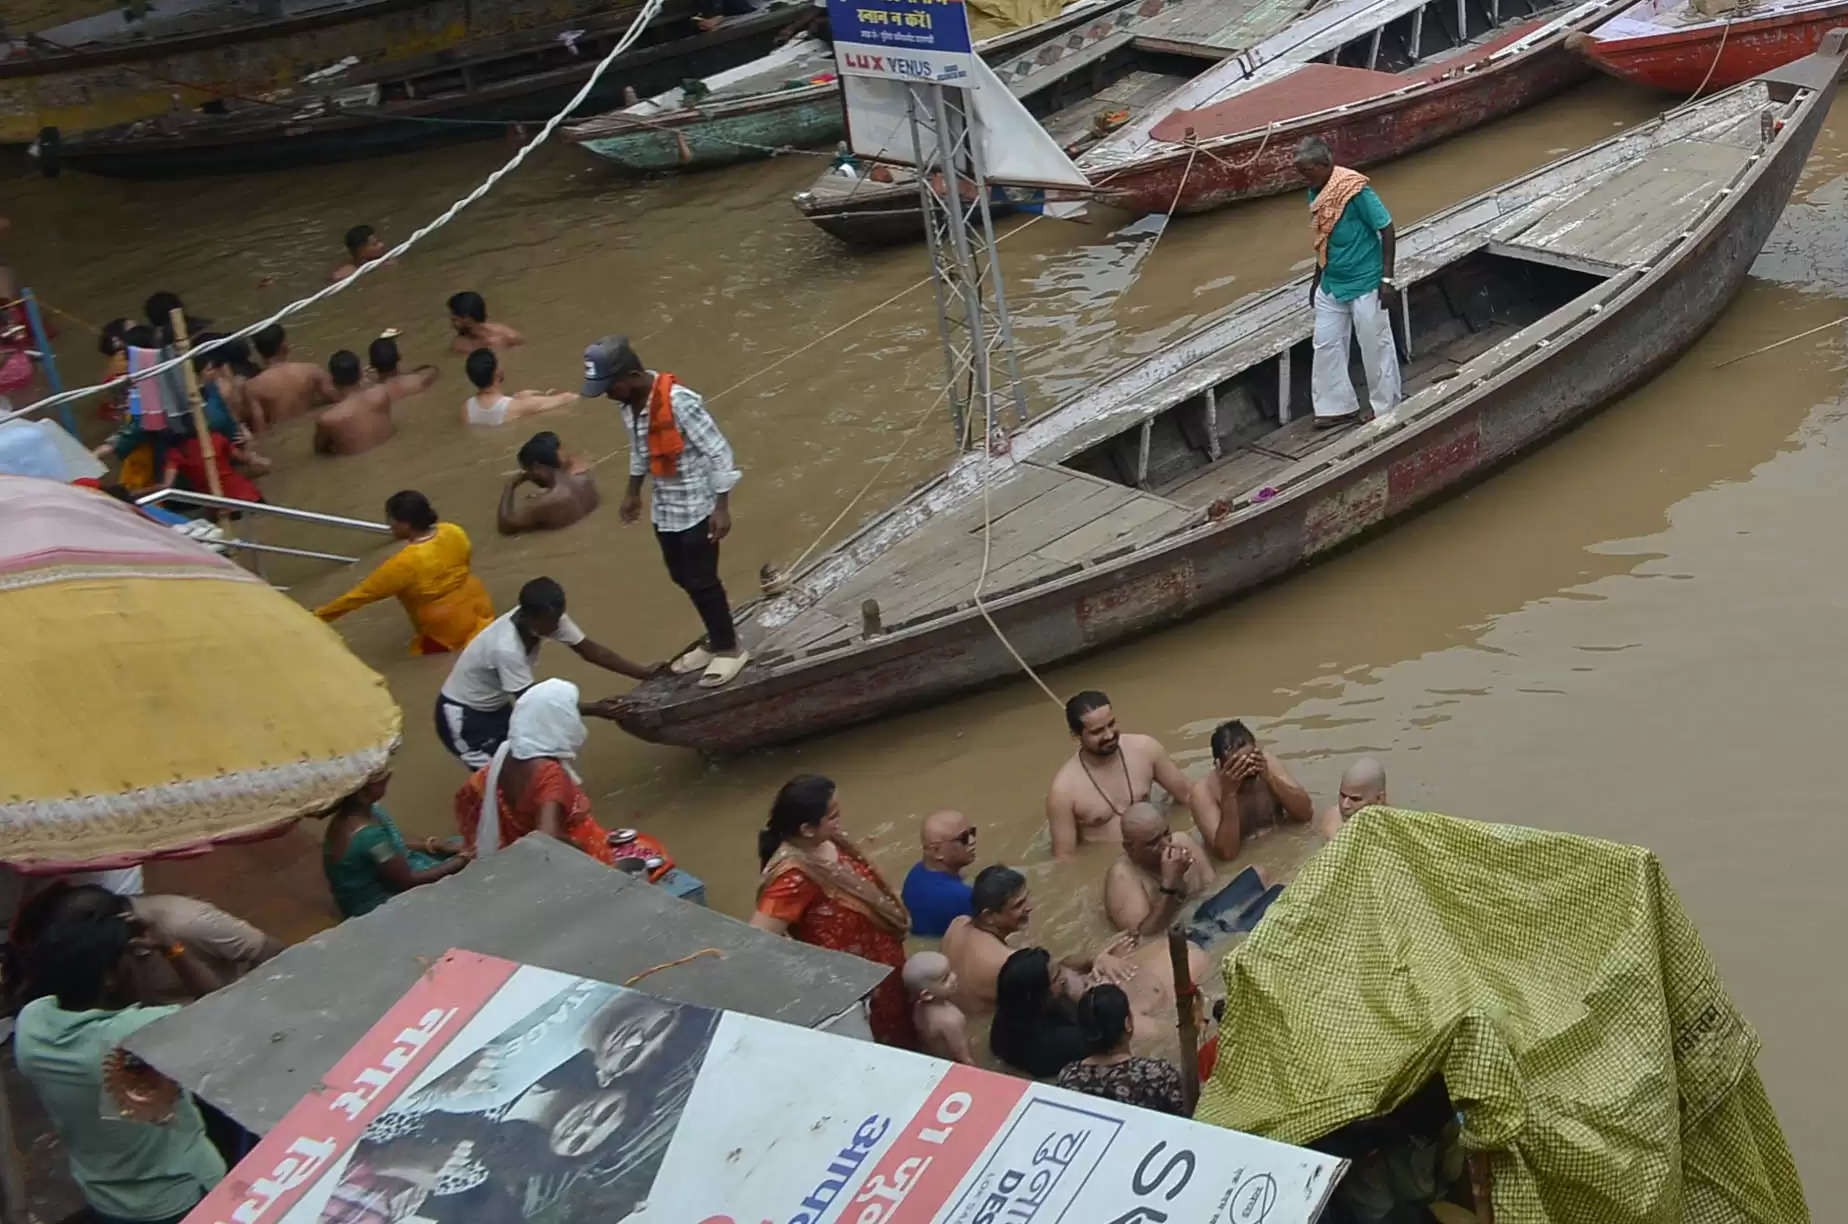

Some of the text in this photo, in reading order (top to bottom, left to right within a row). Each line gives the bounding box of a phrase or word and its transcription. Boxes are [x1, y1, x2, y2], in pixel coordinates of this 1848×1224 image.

[856, 8, 888, 25] स्नान
[889, 12, 902, 26] न
[845, 53, 885, 73] LUX
[887, 57, 932, 77] VENUS
[329, 1007, 459, 1121] नगर
[917, 1091, 973, 1145] 01
[1003, 1129, 1091, 1224] चुना
